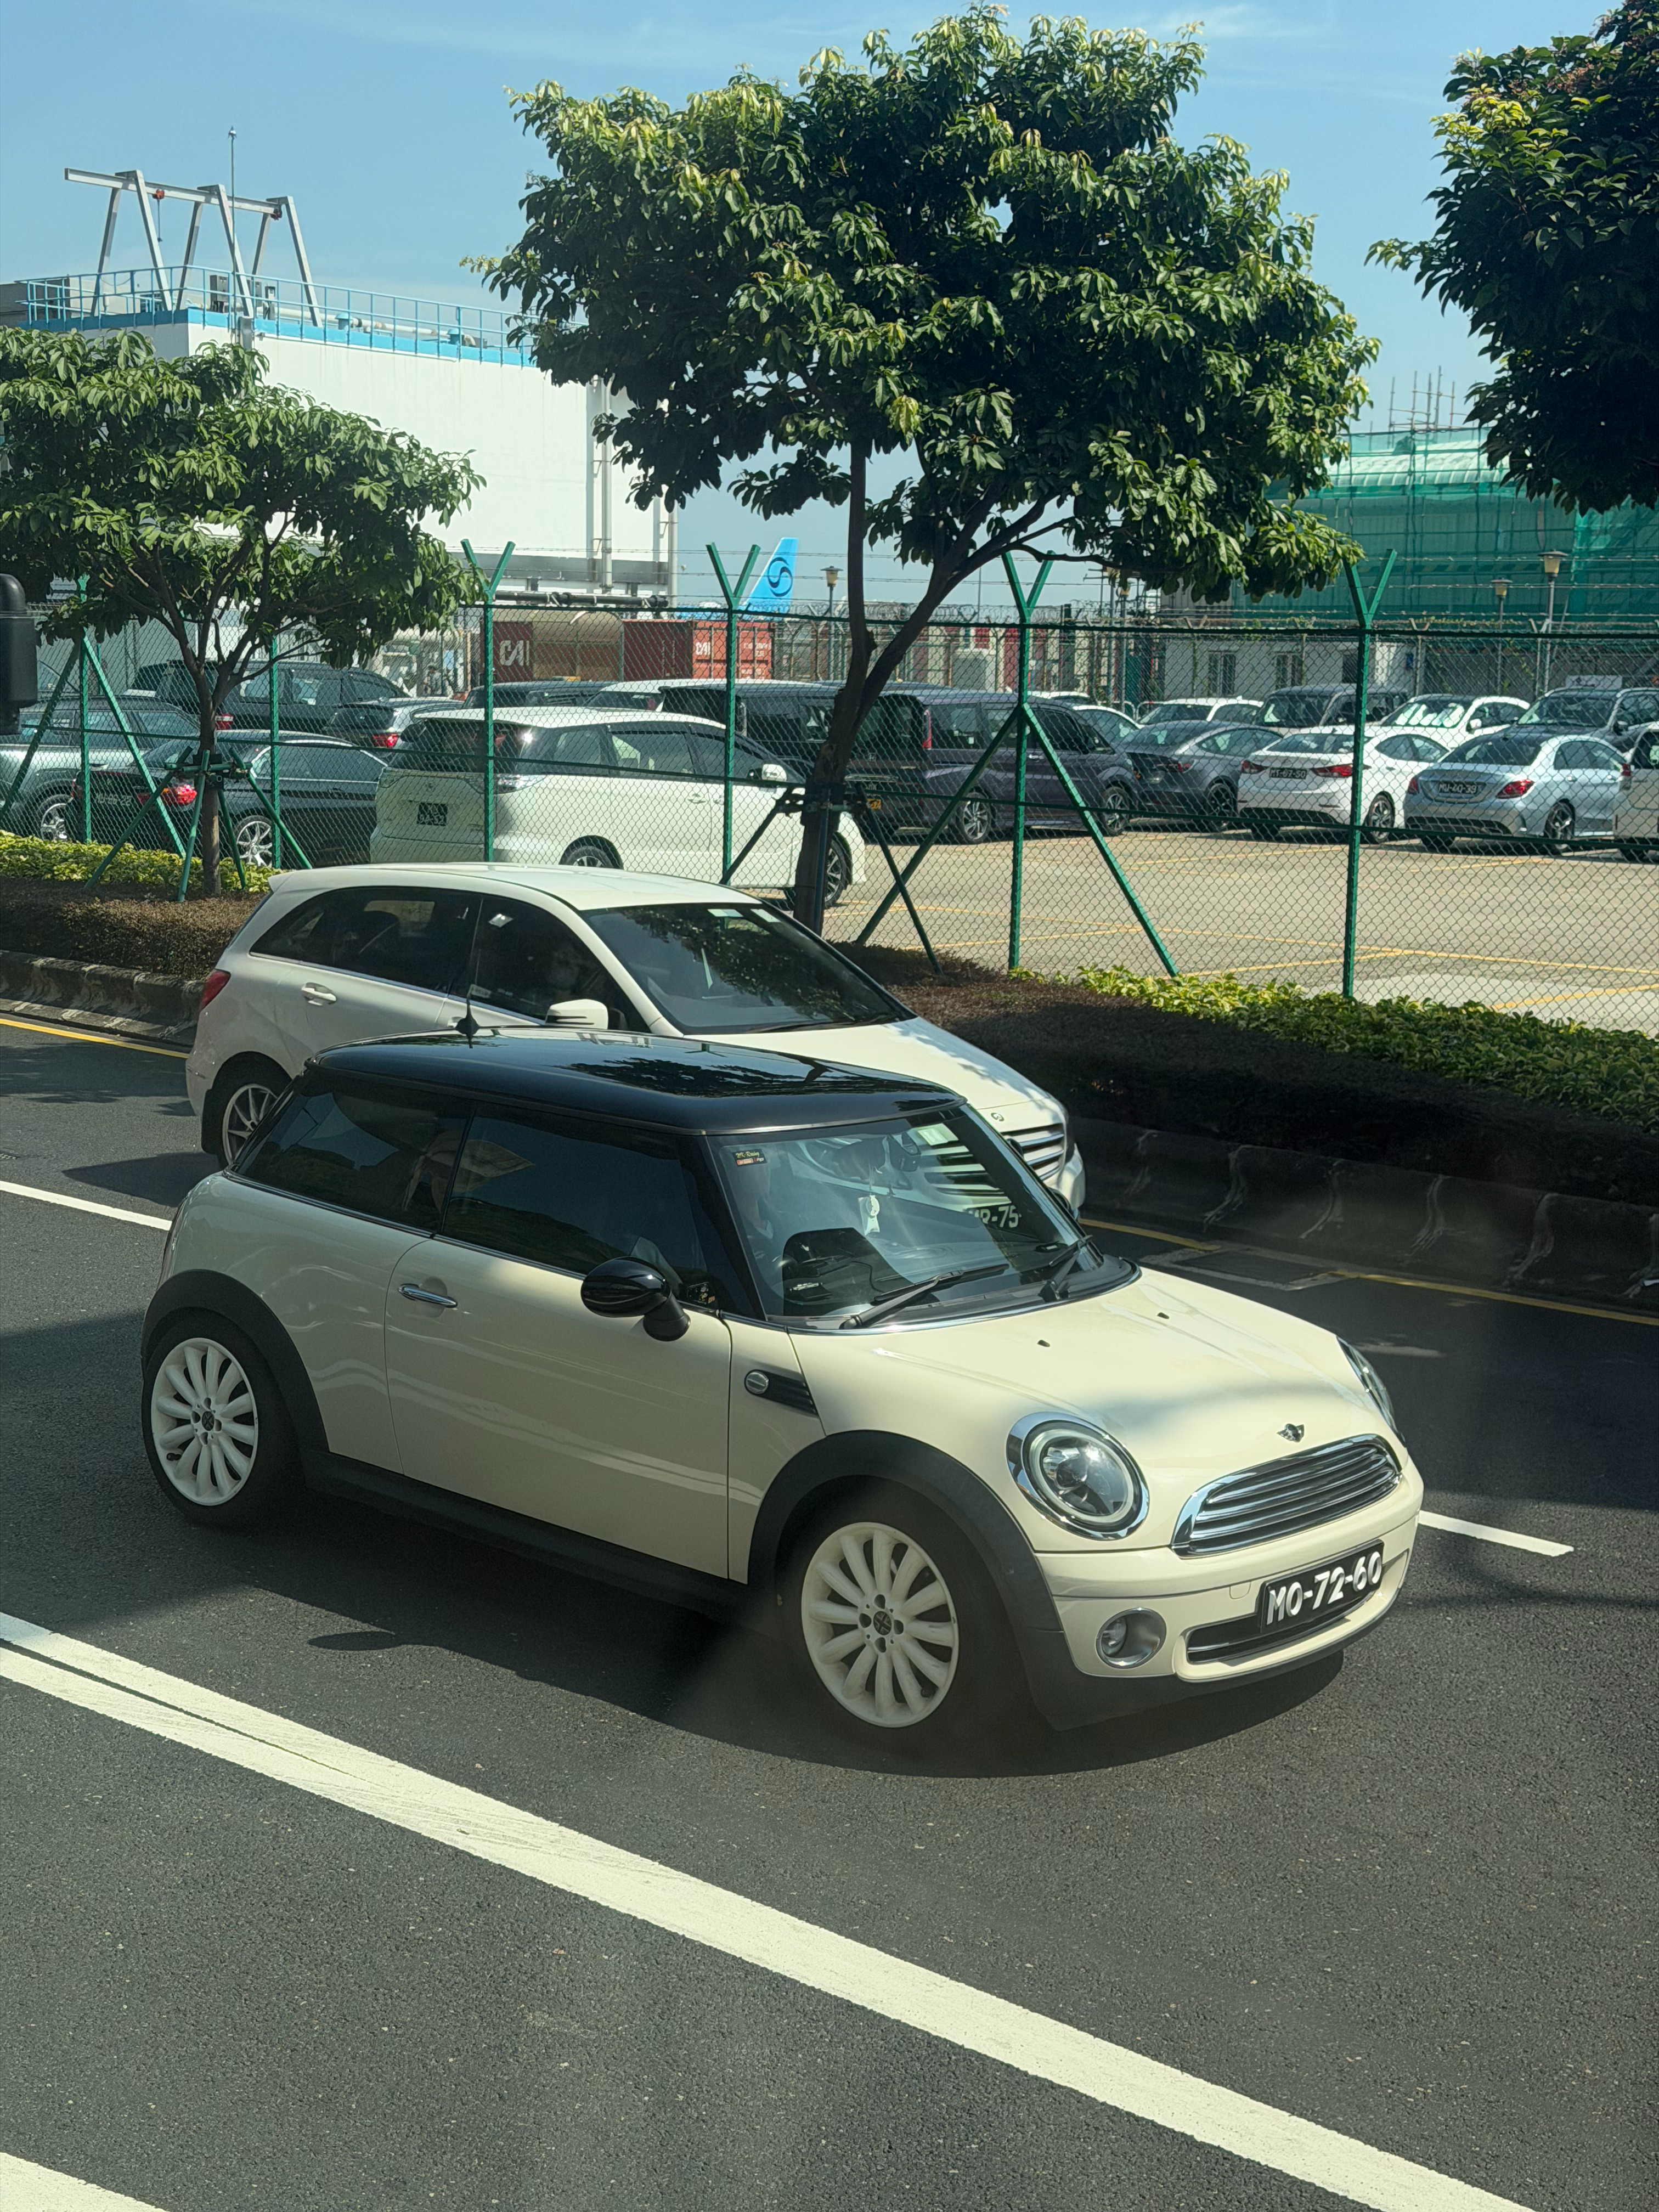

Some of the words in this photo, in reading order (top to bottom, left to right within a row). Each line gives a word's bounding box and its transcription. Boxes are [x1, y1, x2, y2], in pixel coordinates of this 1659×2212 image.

[499, 640, 530, 667] CAI
[695, 641, 711, 656] CAI
[1266, 1551, 1383, 1626] MO-72-60
